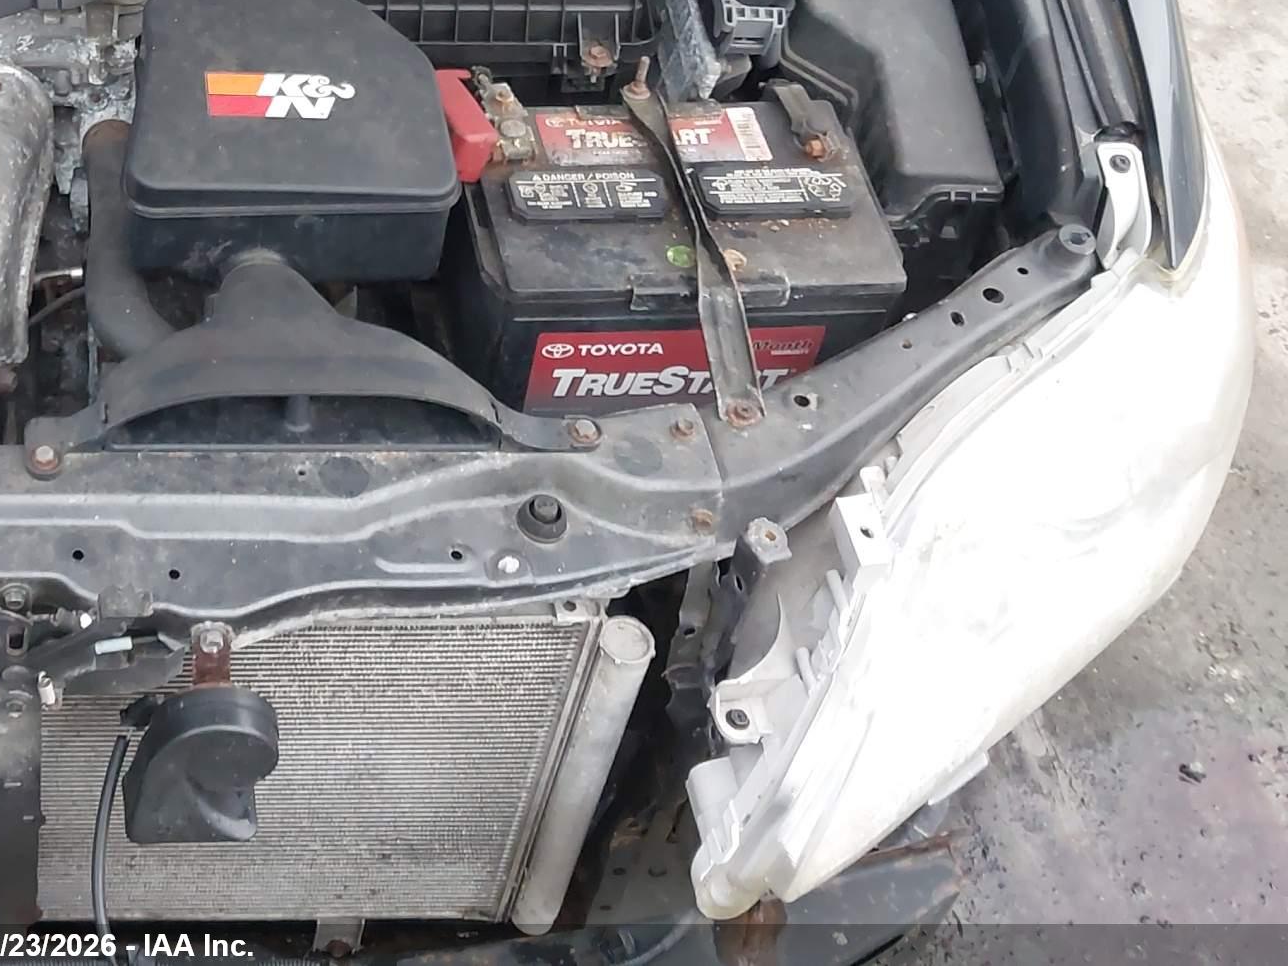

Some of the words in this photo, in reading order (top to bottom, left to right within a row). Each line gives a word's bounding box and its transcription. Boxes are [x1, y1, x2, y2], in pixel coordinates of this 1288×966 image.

[256, 73, 356, 119] K&N
[543, 173, 585, 181] DANGER
[578, 343, 663, 356] TOYOTA
